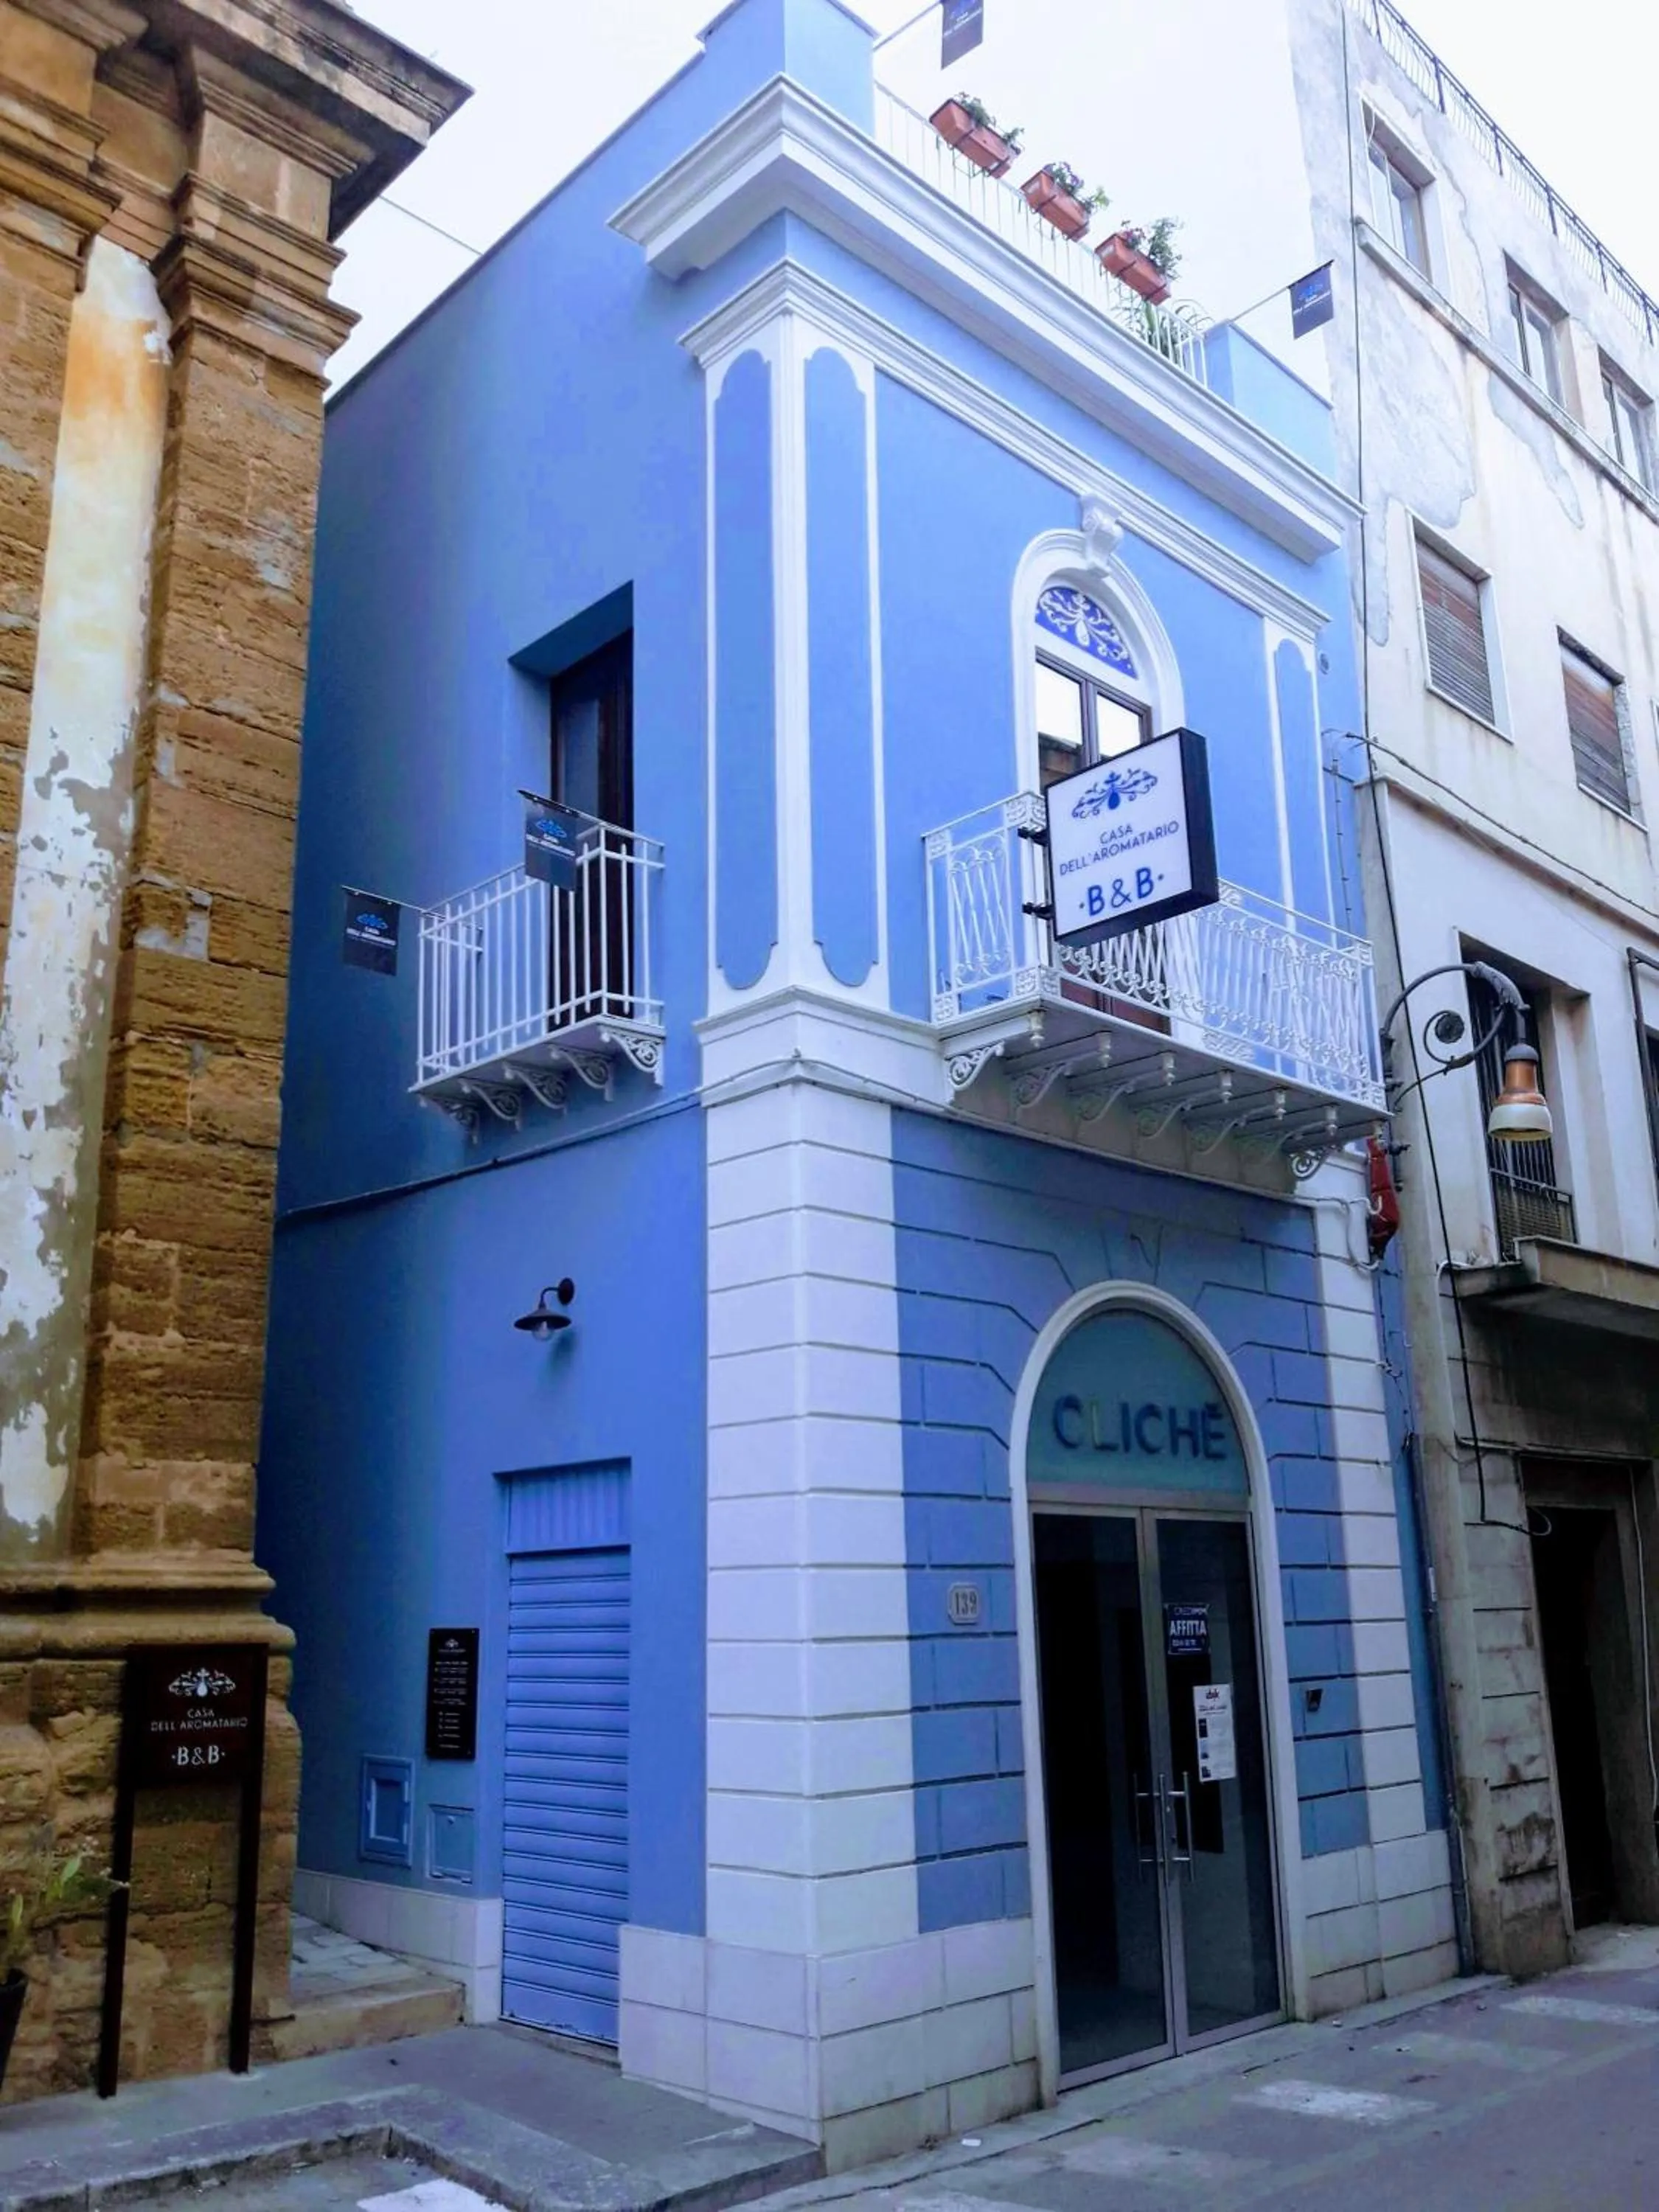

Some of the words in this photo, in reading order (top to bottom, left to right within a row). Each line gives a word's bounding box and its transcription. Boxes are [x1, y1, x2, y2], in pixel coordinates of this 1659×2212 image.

[1099, 823, 1133, 845] CASA
[1060, 820, 1180, 877] DELL'AROMATARIO
[1169, 1620, 1207, 1636] AFFITTA
[186, 1707, 215, 1719] CASA
